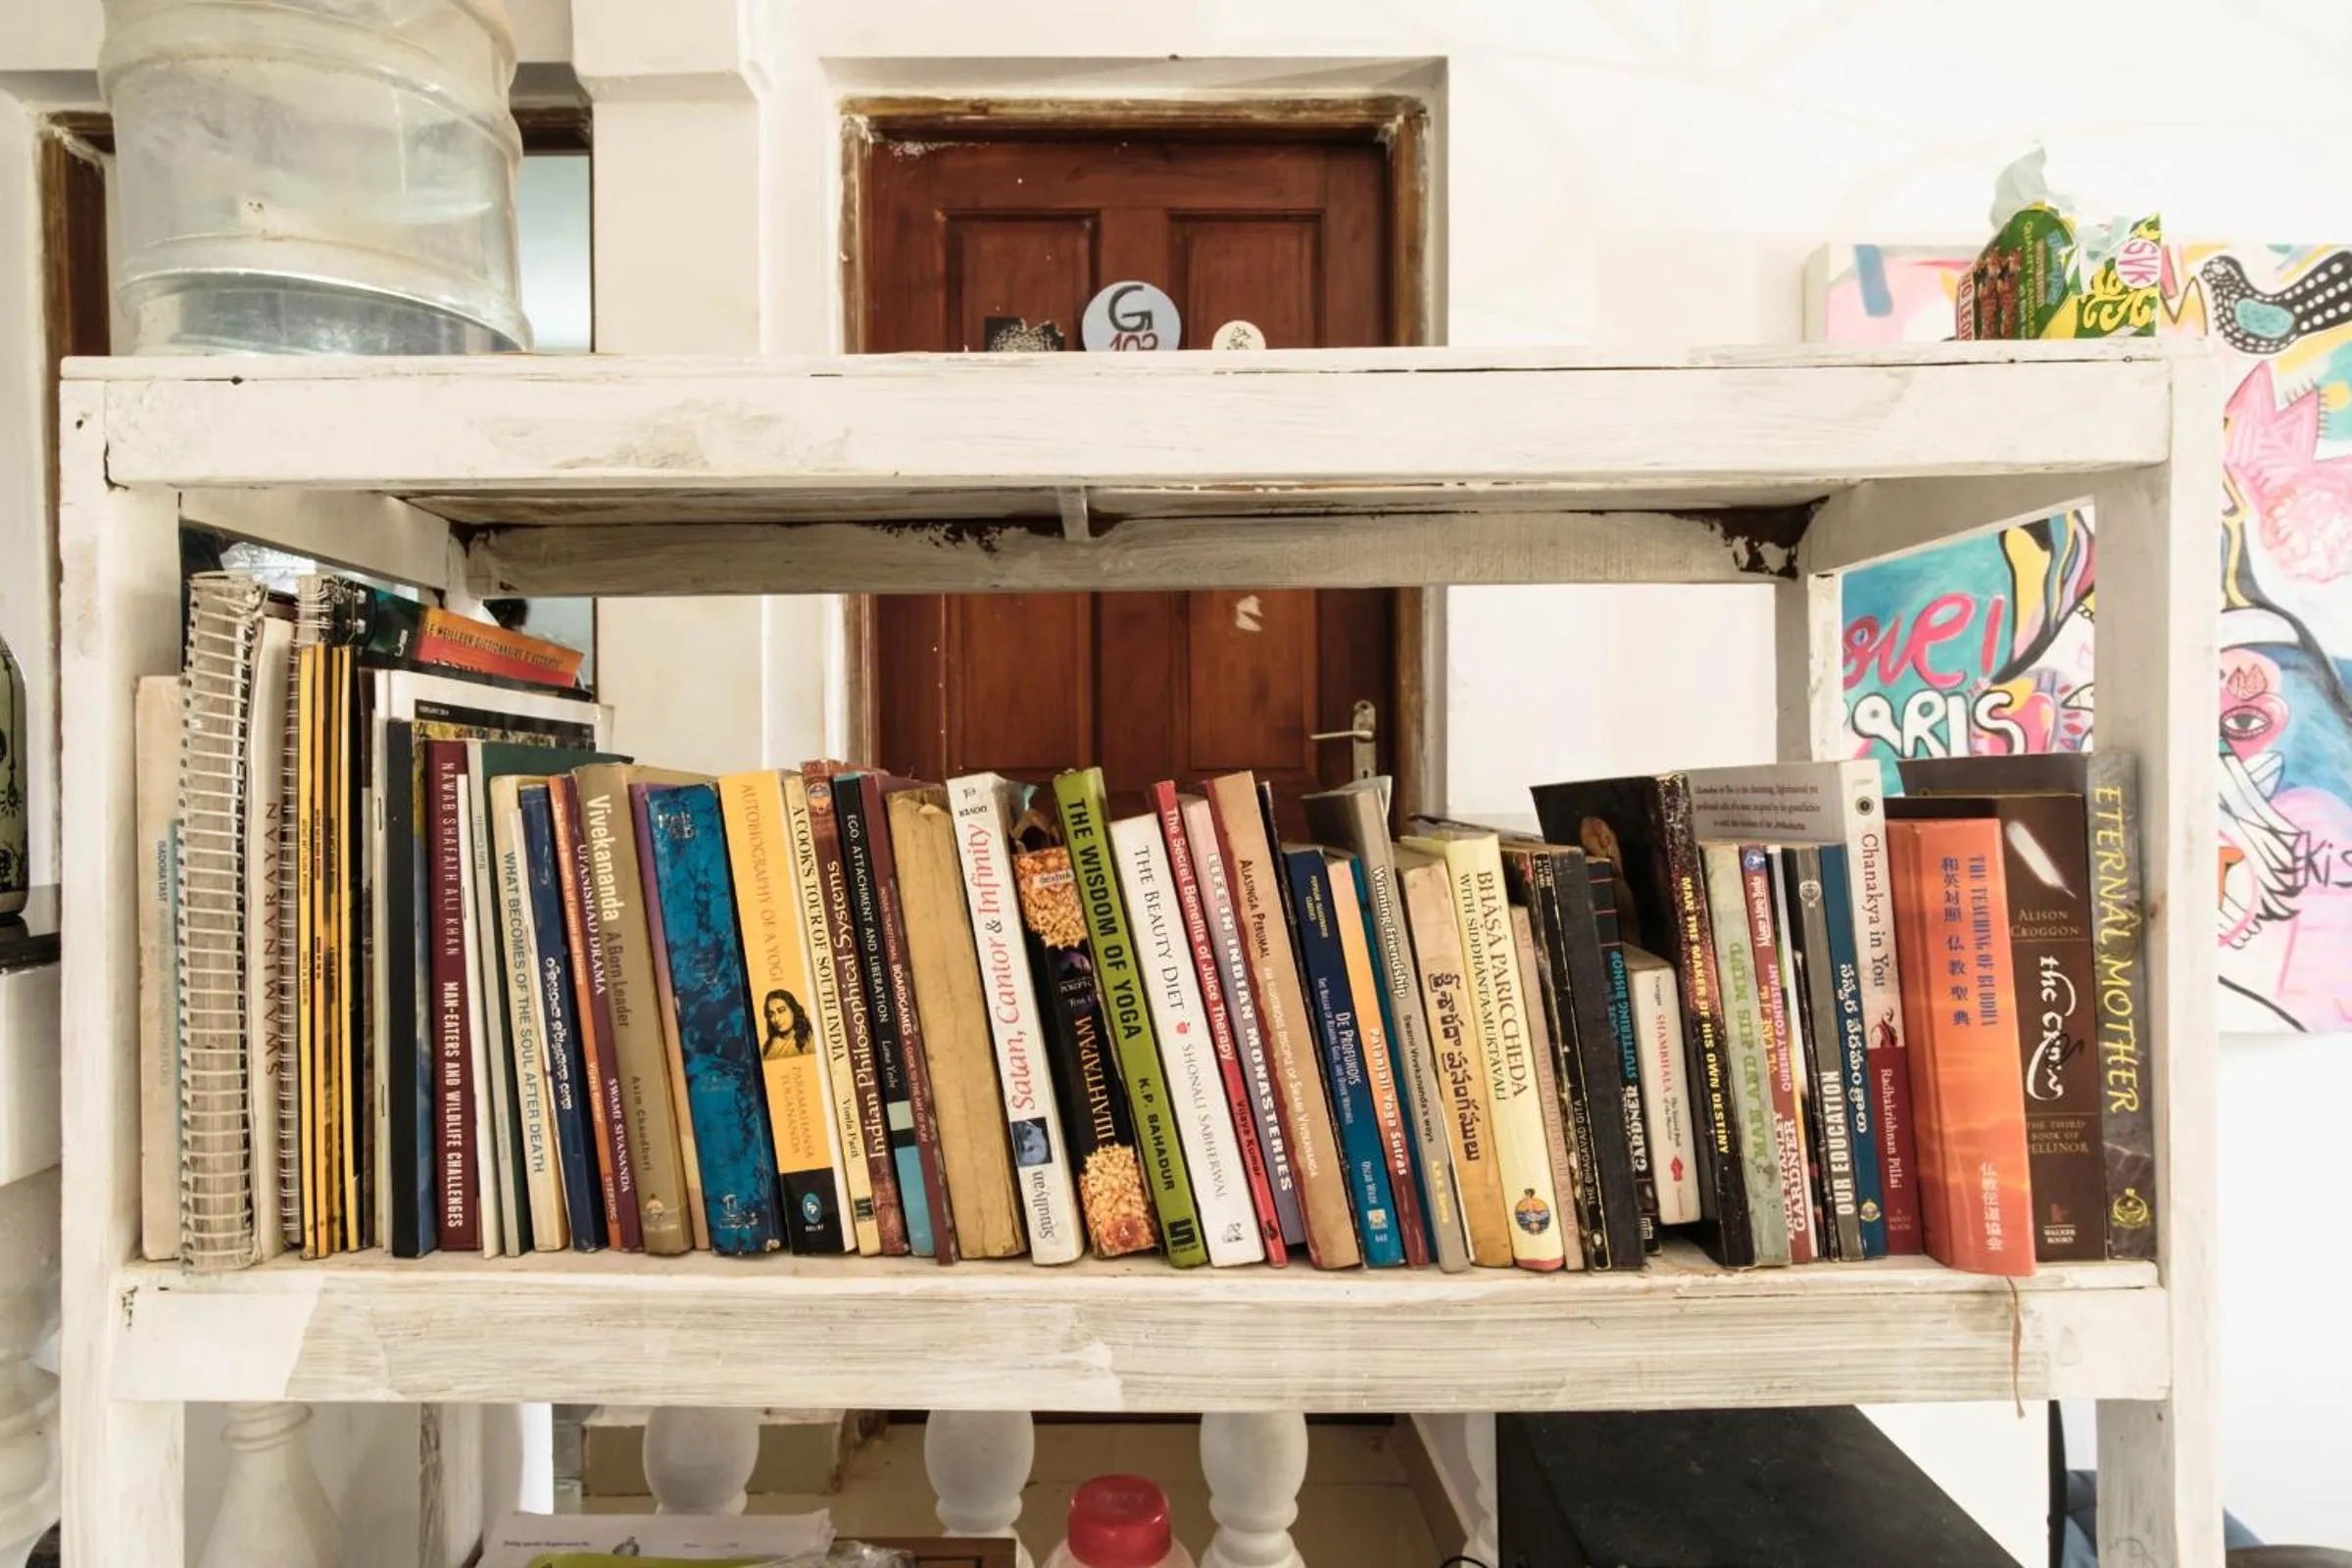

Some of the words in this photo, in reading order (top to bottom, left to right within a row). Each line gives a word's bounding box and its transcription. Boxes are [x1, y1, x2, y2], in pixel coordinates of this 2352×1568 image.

[1108, 285, 1152, 331] G
[1842, 690, 2027, 758] ARIS
[441, 762, 457, 811] NAWAB
[791, 806, 805, 816] A
[739, 785, 772, 904] AUTOBIOGRAPHY
[1066, 799, 1089, 839] THE
[1165, 808, 1181, 834] The
[443, 818, 457, 881] SHAFATH
[503, 852, 521, 893] WHAT
[587, 795, 624, 921] Vivekananda
[796, 819, 815, 877] COOK'S
[967, 823, 1004, 915] Infinity
[1134, 846, 1153, 885] THE
[1174, 838, 1193, 882] Secret
[2094, 785, 2131, 947] ETERNAL
[444, 889, 458, 910] ALI
[805, 882, 824, 926] TOUR
[827, 860, 853, 948] Systems
[853, 846, 872, 921] ATTACHMENT
[1078, 846, 1118, 937] WISDOM
[1459, 873, 1476, 914] WITH
[1681, 877, 1694, 909] MAN
[1861, 833, 1884, 924] Chanakya
[265, 803, 279, 1076] SWAMINARAYAN
[446, 917, 459, 956] KHAN
[508, 898, 525, 969] BECOMES
[577, 844, 598, 933] UPANISHAD
[589, 938, 607, 995] DRAMA
[605, 932, 622, 943] A
[760, 909, 776, 927] OF
[763, 933, 777, 943] A
[812, 929, 828, 950] OF
[864, 928, 877, 951] AND
[985, 919, 1004, 933] &
[1143, 891, 1171, 960] BEAUTY
[1184, 885, 1205, 942] Benefits
[1372, 865, 1394, 925] Winning
[1385, 929, 1409, 999] Friendship
[1686, 915, 1698, 941] THE
[1870, 931, 1886, 948] in
[2018, 909, 2069, 921] ALISON
[609, 945, 626, 977] Born
[767, 947, 783, 982] YOGI
[1103, 945, 1126, 971] OF
[1198, 946, 1211, 961] of
[1609, 951, 1625, 999] BISHOP
[1690, 945, 1706, 997] MAKER
[1872, 954, 1889, 987] You
[514, 973, 528, 993] OF
[612, 981, 631, 1028] Leader
[816, 956, 837, 1010] SOUTH
[869, 956, 889, 1022] LIBERATION
[892, 963, 912, 1036] BOARDGAMES
[990, 938, 1020, 1023] Cantor
[1162, 966, 1185, 1011] DIET
[1201, 963, 1220, 1001] Juice
[1769, 963, 1786, 1037] CONTESTANT
[443, 982, 460, 1056] MAN-EATERS
[518, 999, 533, 1024] THE
[841, 955, 875, 1089] Philosophical
[1113, 979, 1143, 1039] YOGA
[1207, 854, 1227, 902] LIFE
[1218, 906, 1233, 931] IN
[1227, 938, 1253, 1020] INDIAN
[1246, 1029, 1294, 1192] MONASTERIES
[1211, 1004, 1234, 1061] Therapy
[1336, 1011, 1351, 1028] DE
[1490, 953, 1529, 1098] PARICCHEDA
[1696, 1001, 1709, 1018] OF
[2100, 955, 2139, 1115] MOTHER
[520, 1029, 536, 1065] SOUL
[827, 1015, 845, 1061] INDIA
[1338, 1030, 1361, 1086] PROFUNDIS
[1617, 1002, 1638, 1079] STUTTERING
[1654, 1013, 1672, 1093] SHAMBHALA
[1699, 1023, 1713, 1049] HIS
[445, 1062, 461, 1086] AND
[1006, 1031, 1036, 1110] Satan,
[1074, 1015, 1116, 1140] ШАНТАРАМ
[1181, 1044, 1206, 1109] SHONALI
[1706, 1054, 1719, 1088] OWN
[1776, 1039, 1791, 1092] QUEENLY
[446, 1091, 462, 1147] WILDLIFE
[522, 1072, 539, 1118] AFTER
[608, 1078, 621, 1119] SWAMI
[1370, 1028, 1391, 1090] Patanjali
[1381, 1094, 1397, 1127] Yoga
[1390, 1132, 1407, 1176] Sutras
[1573, 1100, 1585, 1123] GITA
[1821, 1071, 1850, 1172] EDUCATION
[1880, 1069, 1899, 1154] Radhakrishnan
[528, 1124, 545, 1172] DEATH
[866, 1093, 887, 1158] Indian
[1138, 1079, 1152, 1106] K.P.
[1146, 1114, 1175, 1191] BAHADUR
[1235, 1100, 1252, 1137] Vijaya
[1245, 1139, 1261, 1176] Kumar
[1626, 1085, 1648, 1172] GARDNER
[1711, 1094, 1729, 1153] DESTINY
[612, 1124, 631, 1193] SIVANANDA
[1784, 1119, 1806, 1232] GARDNER
[1887, 1157, 1902, 1189] Pillai
[447, 1152, 463, 1227] CHALLENGES
[1032, 1171, 1055, 1239] Smullyan
[1833, 1179, 1855, 1215] OUR
